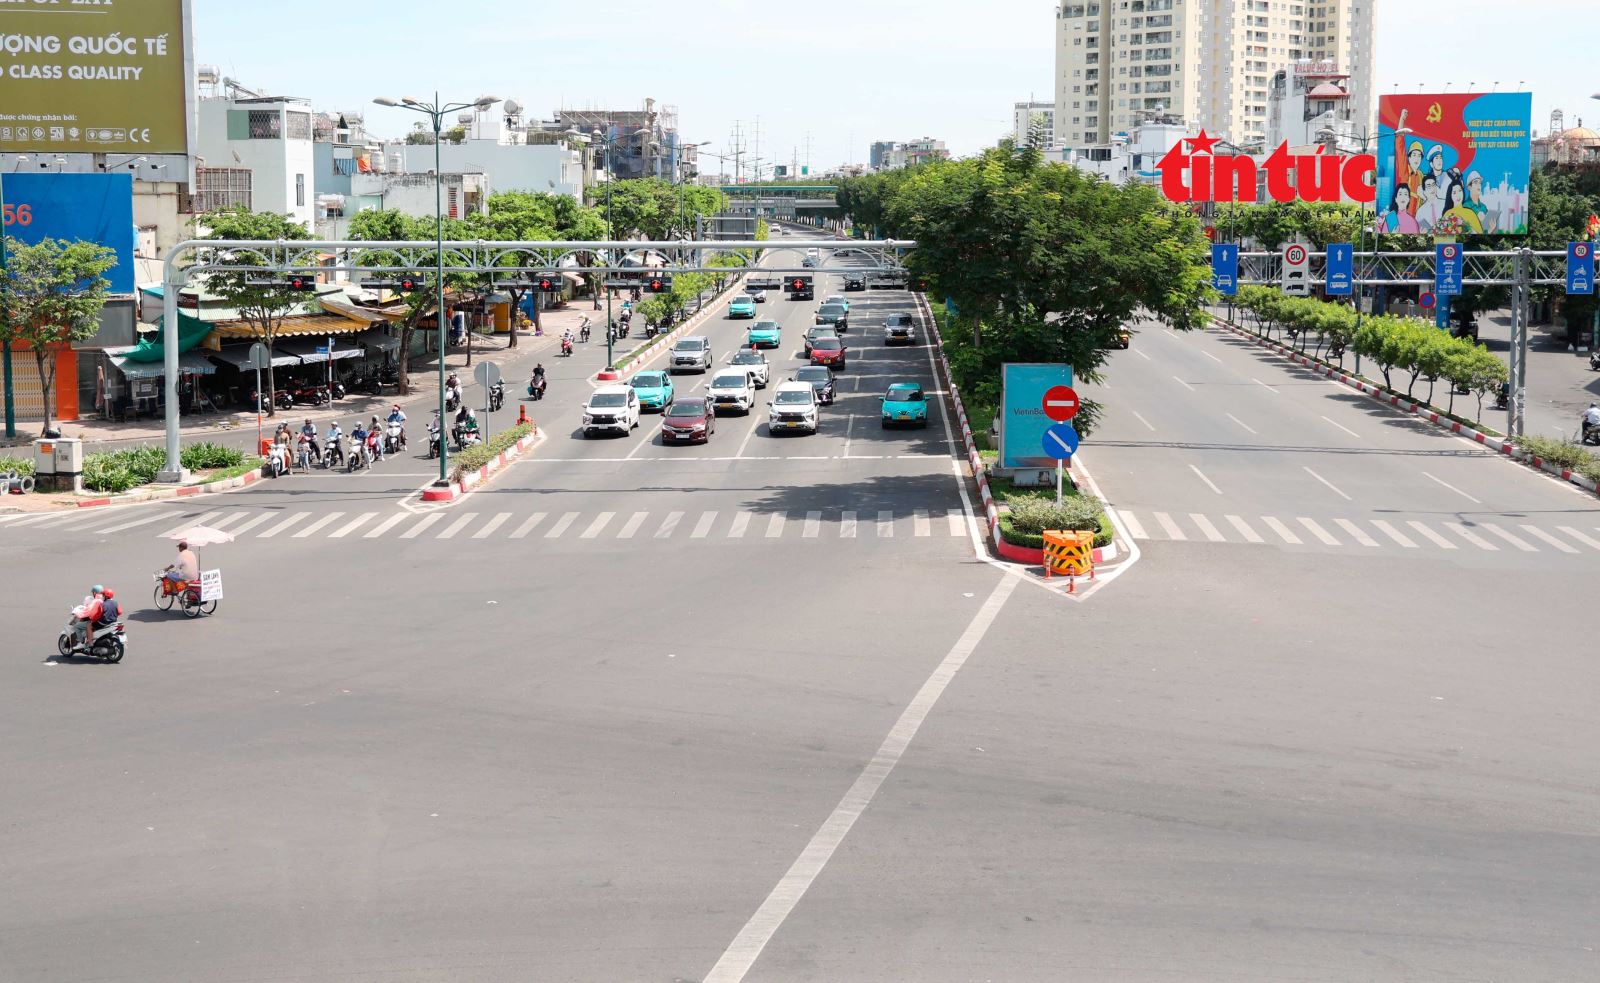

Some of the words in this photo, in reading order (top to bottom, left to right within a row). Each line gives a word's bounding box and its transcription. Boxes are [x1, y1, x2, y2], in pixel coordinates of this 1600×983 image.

[68, 31, 137, 55] QUỐC
[143, 33, 169, 55] TẾ
[9, 65, 63, 79] CLASS
[68, 66, 143, 80] QUALITY
[1290, 250, 1301, 261] 60
[1577, 247, 1585, 255] 50
